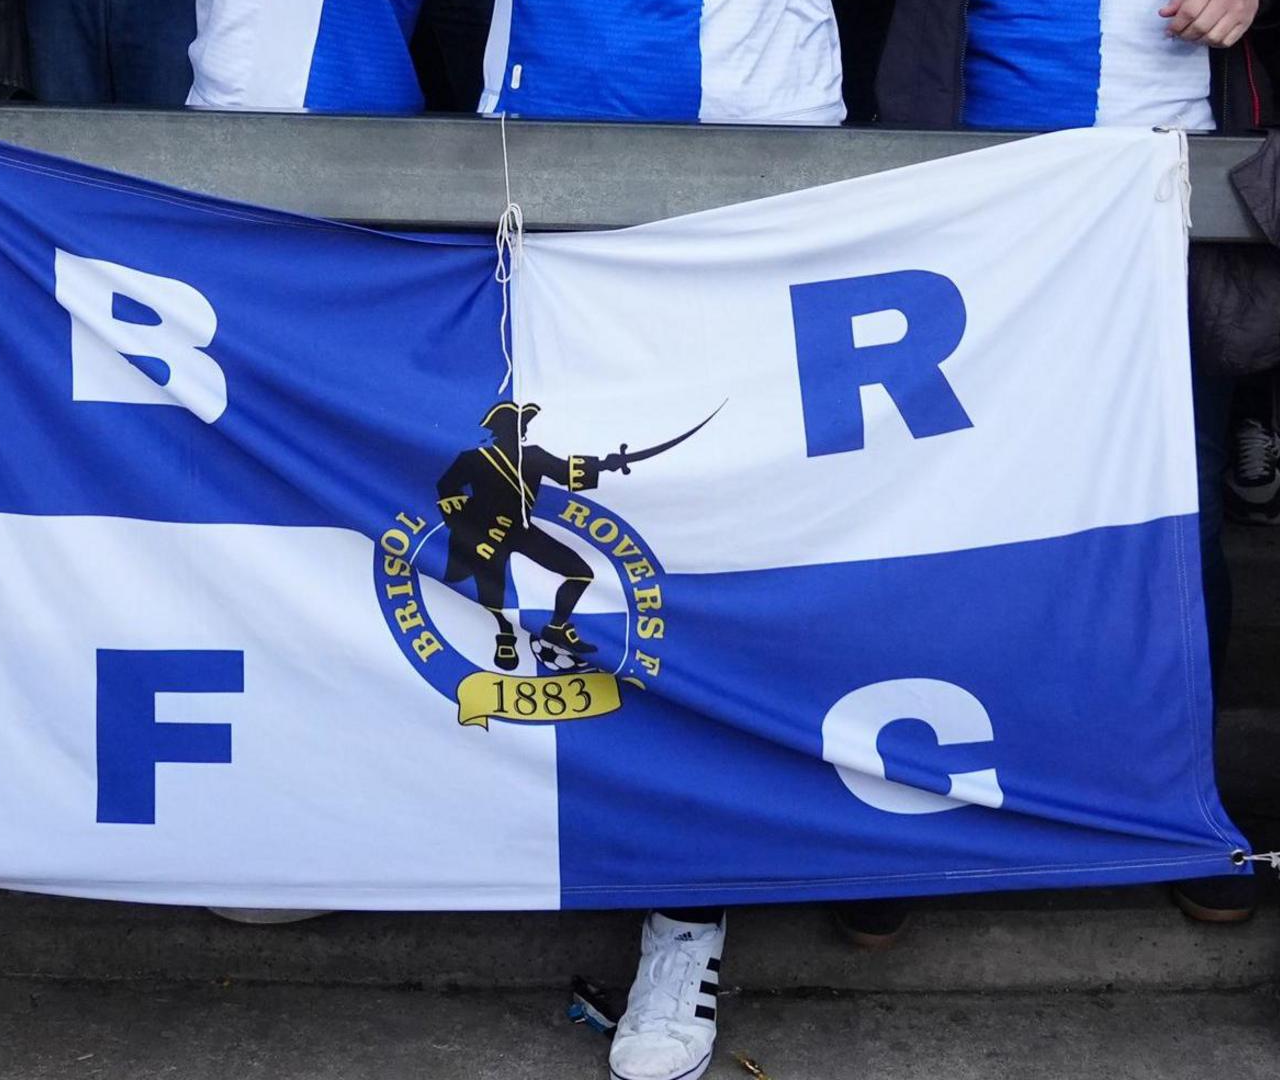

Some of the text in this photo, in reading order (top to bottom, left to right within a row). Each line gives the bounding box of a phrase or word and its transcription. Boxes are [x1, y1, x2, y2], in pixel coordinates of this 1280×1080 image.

[53, 247, 976, 459] B R
[557, 499, 666, 640] ROVERS
[95, 647, 1004, 824] F C
[492, 678, 593, 716] 1883
